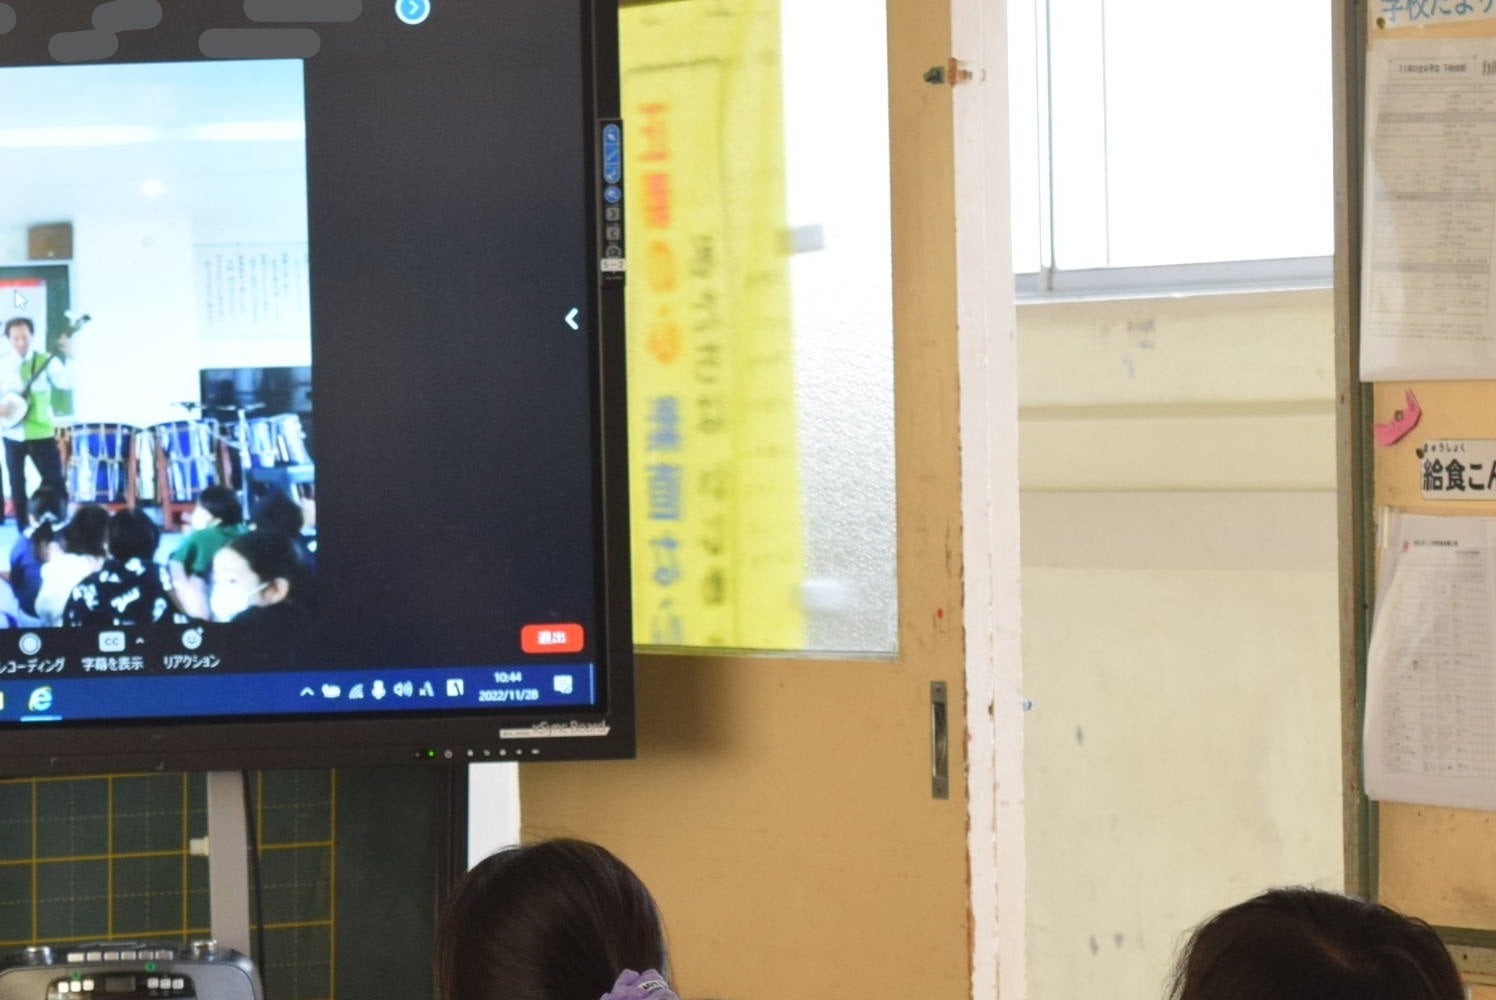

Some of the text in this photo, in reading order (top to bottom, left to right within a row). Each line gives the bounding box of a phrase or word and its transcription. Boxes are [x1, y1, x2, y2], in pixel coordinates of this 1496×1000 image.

[81, 655, 145, 672] 字幕を表示
[163, 654, 221, 670] リアクション
